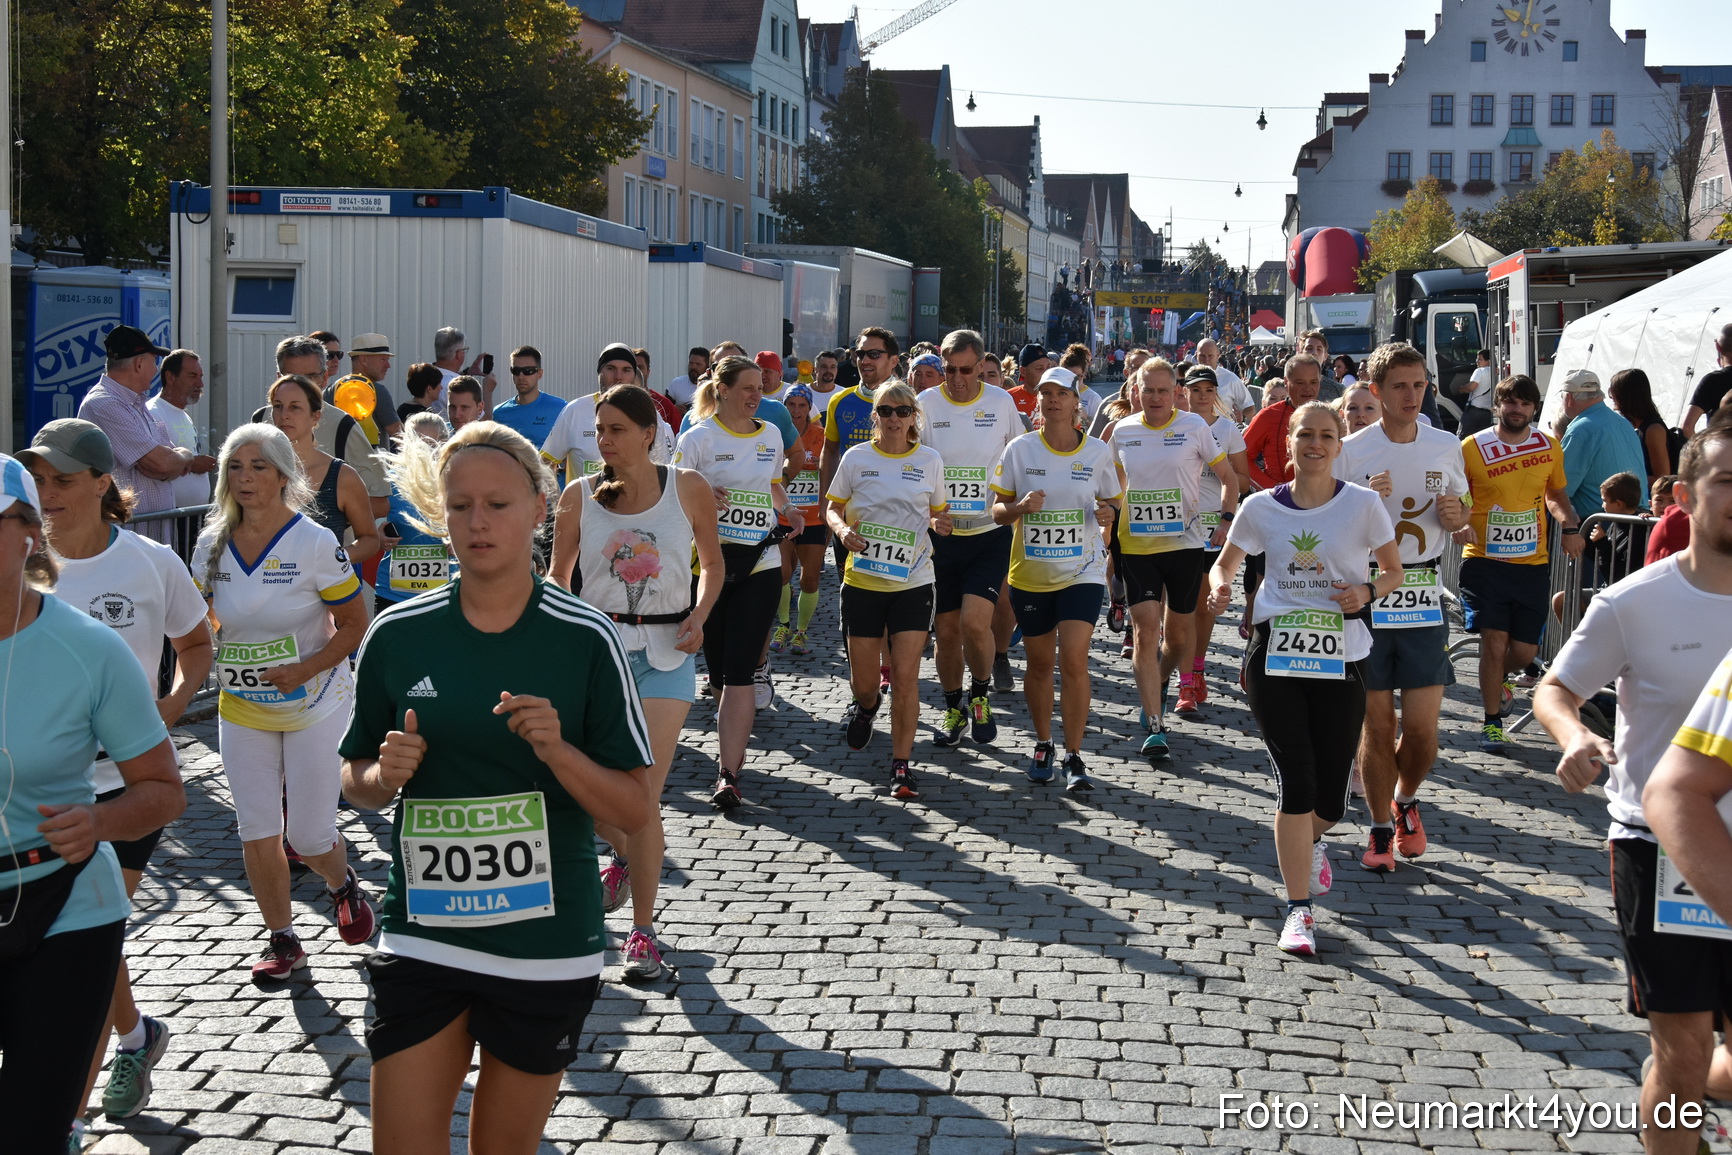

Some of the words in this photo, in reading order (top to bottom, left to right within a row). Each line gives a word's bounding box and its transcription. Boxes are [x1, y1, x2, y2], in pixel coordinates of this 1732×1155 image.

[56, 294, 80, 303] 08141
[87, 296, 101, 304] 536
[103, 296, 113, 304] 80
[1131, 296, 1170, 305] START
[1487, 462, 1518, 478] MAX
[1522, 454, 1553, 469] BÖGL
[944, 468, 982, 479] OCK
[786, 483, 814, 493] 272
[1427, 478, 1442, 487] 30
[944, 483, 980, 498] 123
[1131, 490, 1177, 502] BOCK
[718, 508, 766, 528] 2098
[1028, 512, 1079, 523] BOCK
[1134, 506, 1176, 520] 2113
[1492, 512, 1534, 523] BOCK
[718, 527, 762, 539] SUSANNE
[860, 523, 911, 544] BOCK
[1030, 528, 1076, 544] 2121
[1492, 527, 1532, 542] 2401
[396, 547, 444, 558] BOCK
[860, 541, 905, 563] 2114
[1034, 548, 1073, 556] CLAUDIA
[1498, 545, 1527, 553] MARCO
[264, 559, 279, 569] 20
[398, 562, 442, 577] 1032
[870, 562, 890, 573] LISA
[1278, 580, 1305, 589] ESUND
[1309, 580, 1328, 588] UND
[1379, 590, 1431, 608] 2294
[1278, 612, 1338, 629] BOCK
[1387, 613, 1426, 622] DANIEL
[1276, 632, 1337, 655] 2420
[224, 640, 290, 661] BOCK
[1289, 660, 1321, 670] ANJA
[244, 692, 286, 701] PETRA
[407, 689, 438, 697] adidas
[413, 800, 533, 832] BOCK
[419, 840, 533, 882] 2030
[445, 893, 510, 912] JULIA
